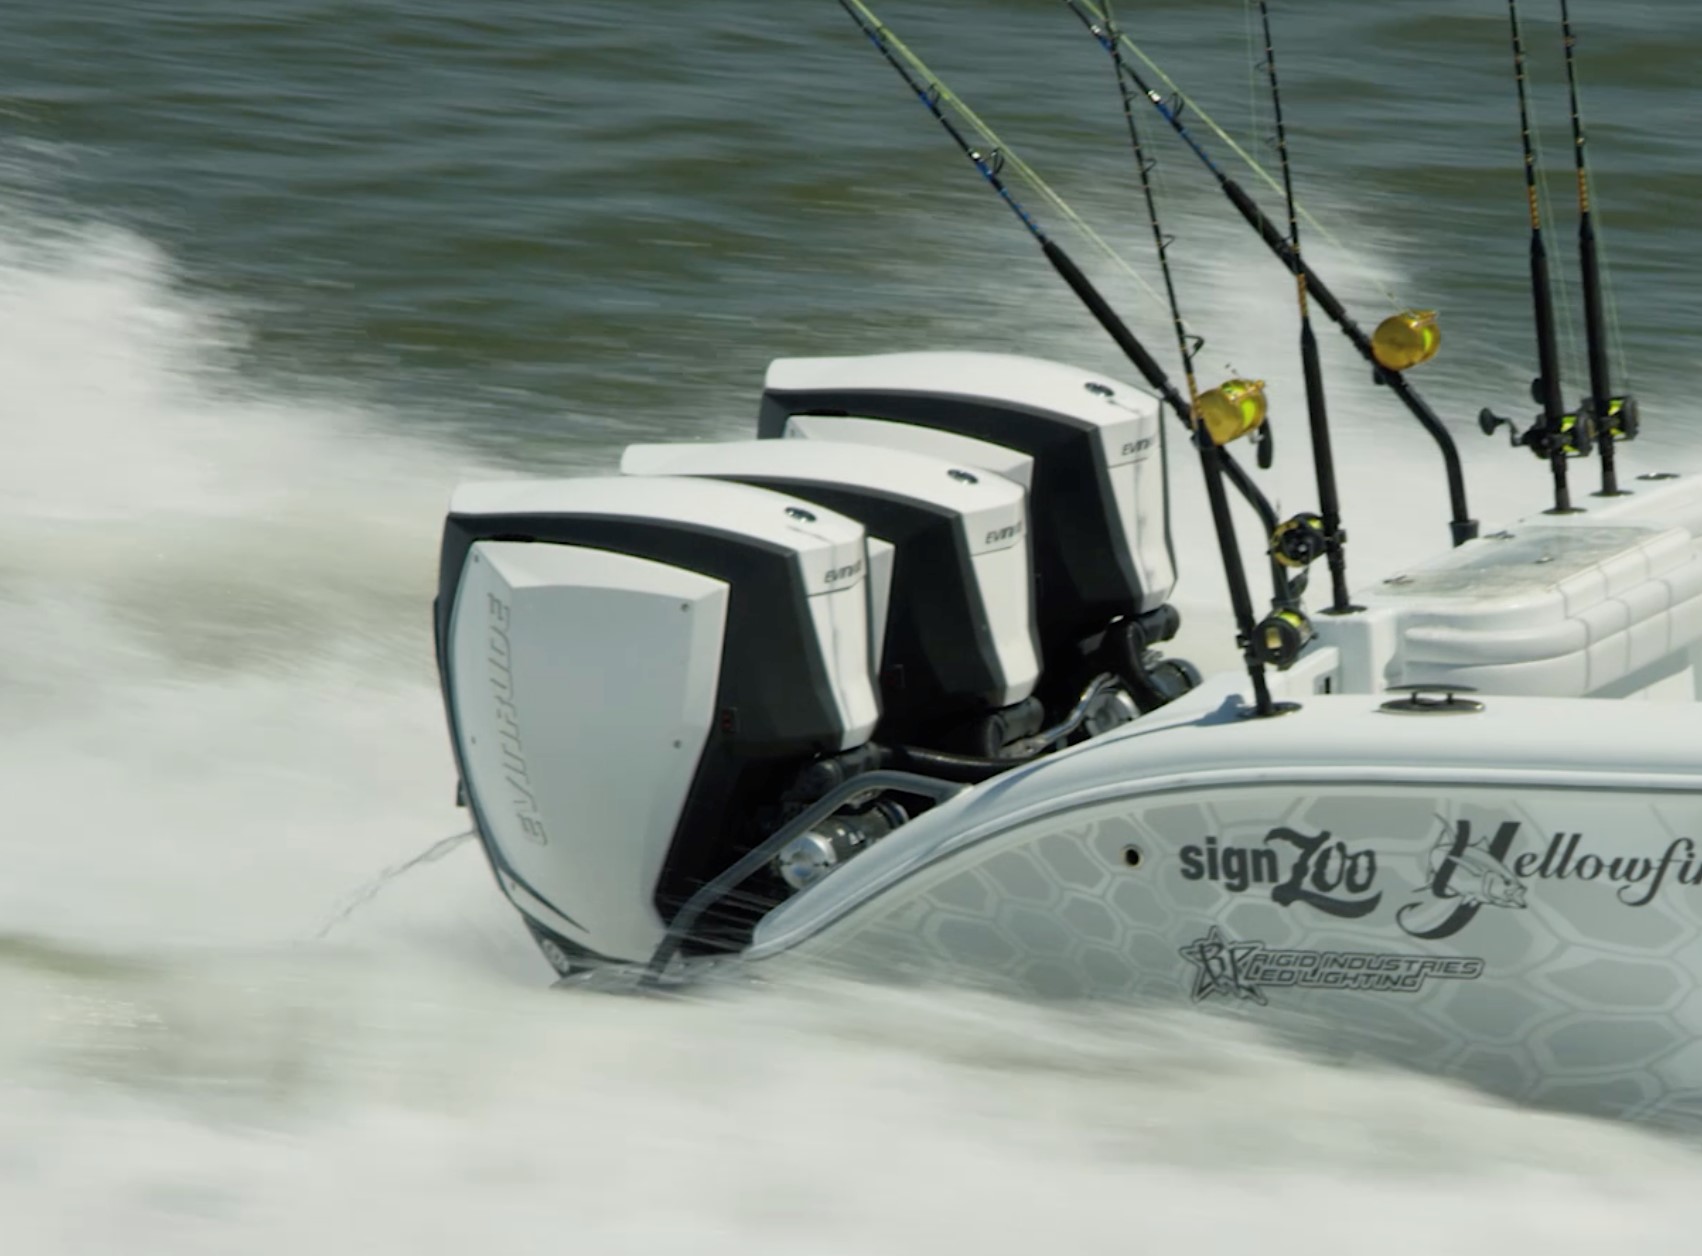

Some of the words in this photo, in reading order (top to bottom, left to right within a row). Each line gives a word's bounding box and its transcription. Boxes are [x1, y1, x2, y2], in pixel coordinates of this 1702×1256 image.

[1251, 953, 1318, 969] RIGID
[1322, 955, 1479, 976] INDUSTRIES
[1244, 967, 1296, 982] LED
[1301, 967, 1419, 988] LIGHTING
